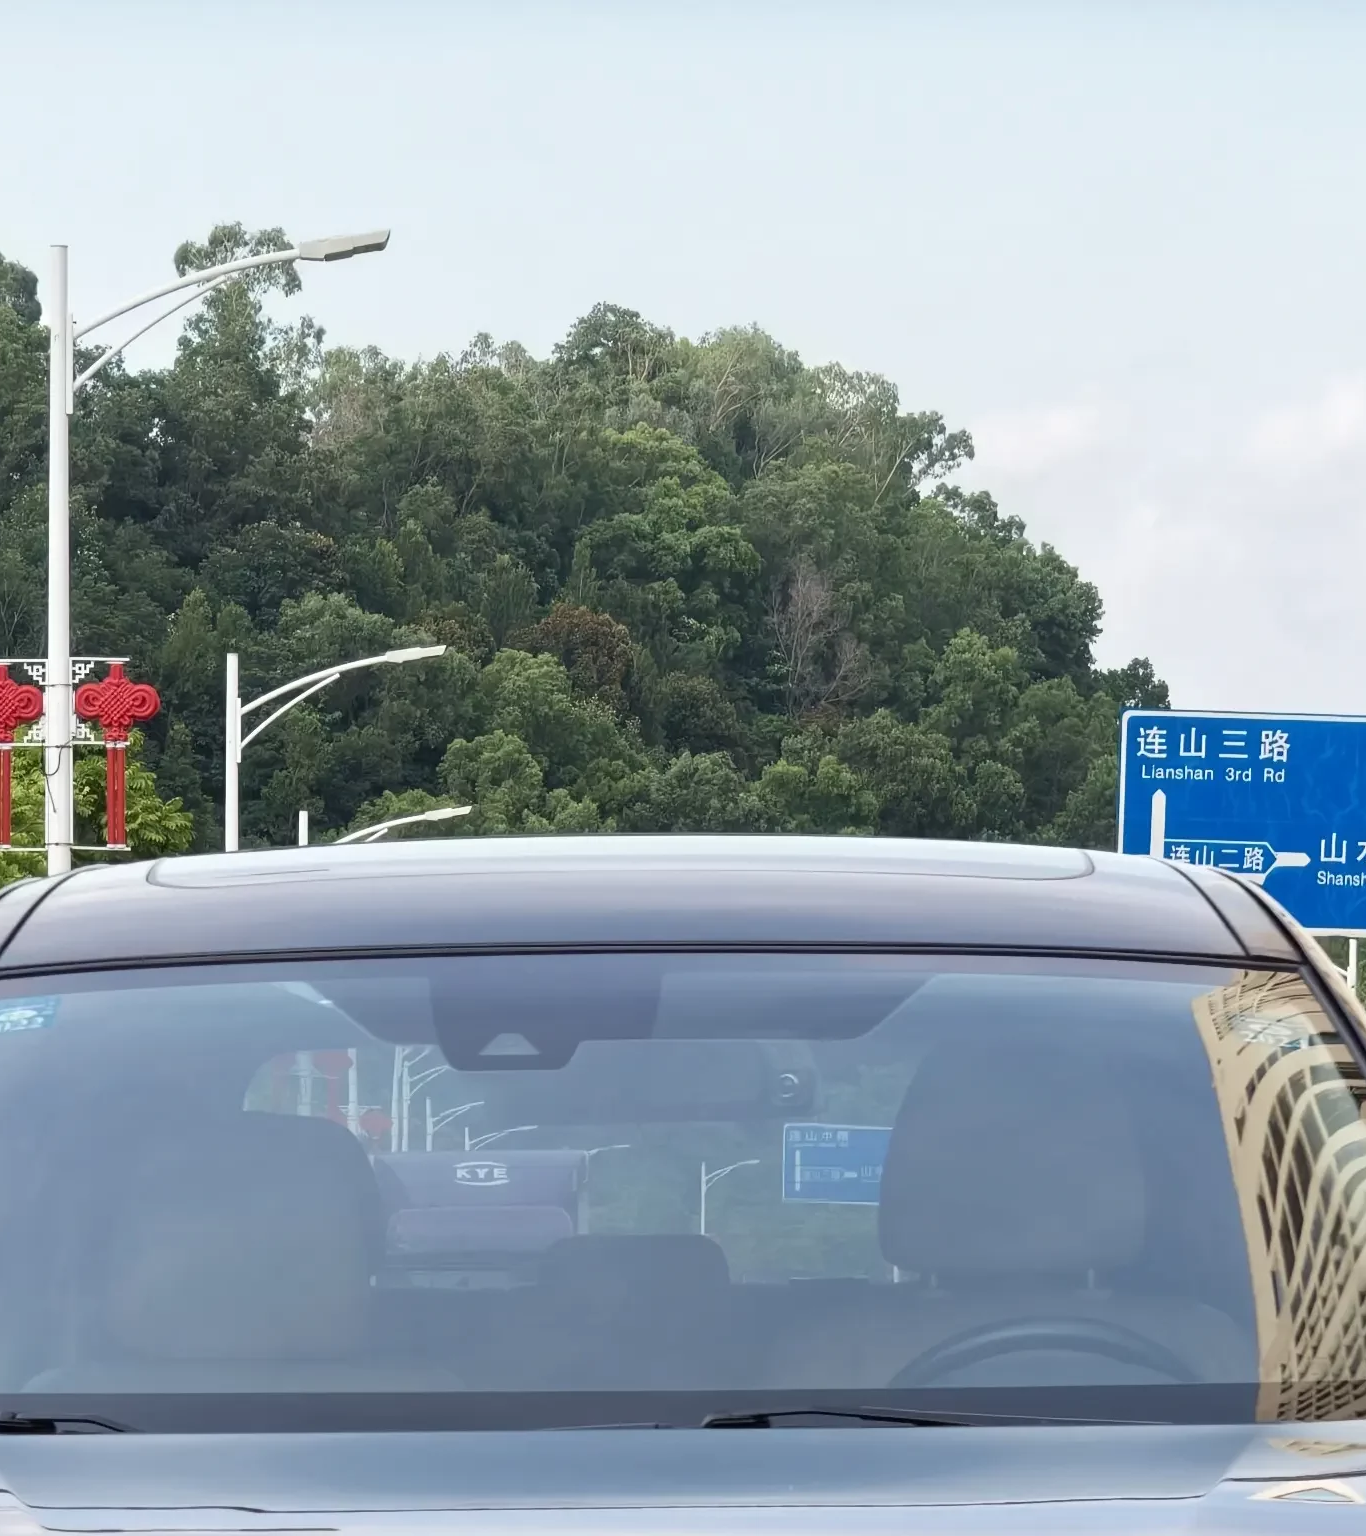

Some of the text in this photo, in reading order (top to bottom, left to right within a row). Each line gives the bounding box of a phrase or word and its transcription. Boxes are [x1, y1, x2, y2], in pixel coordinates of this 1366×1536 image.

[1136, 725, 1291, 763] 连山三路
[1141, 764, 1286, 783] Lianshan 3rd Rd
[1169, 844, 1265, 871] 连山二路
[456, 1167, 508, 1179] KYE
